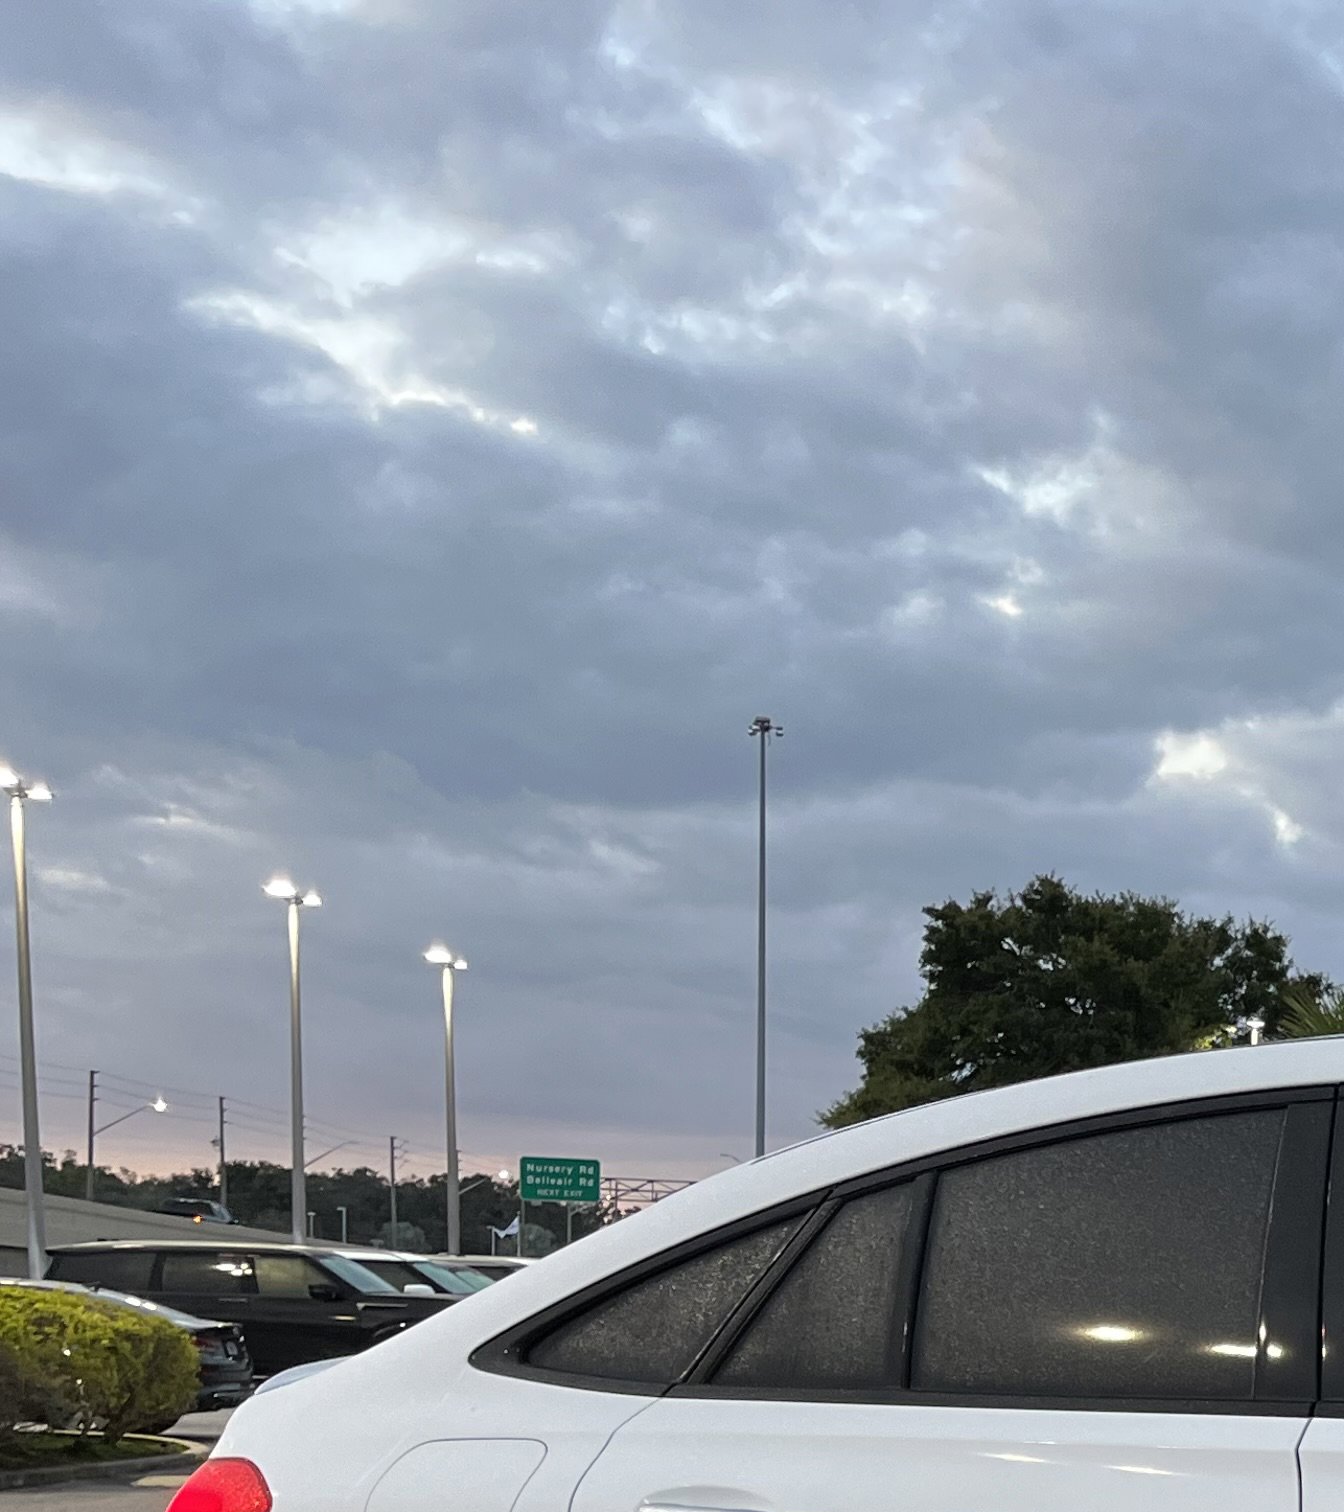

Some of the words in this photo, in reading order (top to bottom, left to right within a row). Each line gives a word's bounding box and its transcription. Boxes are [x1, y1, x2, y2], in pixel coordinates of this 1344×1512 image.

[526, 1163, 573, 1175] Nursery
[579, 1165, 594, 1175] Rd
[579, 1177, 594, 1187] Rd
